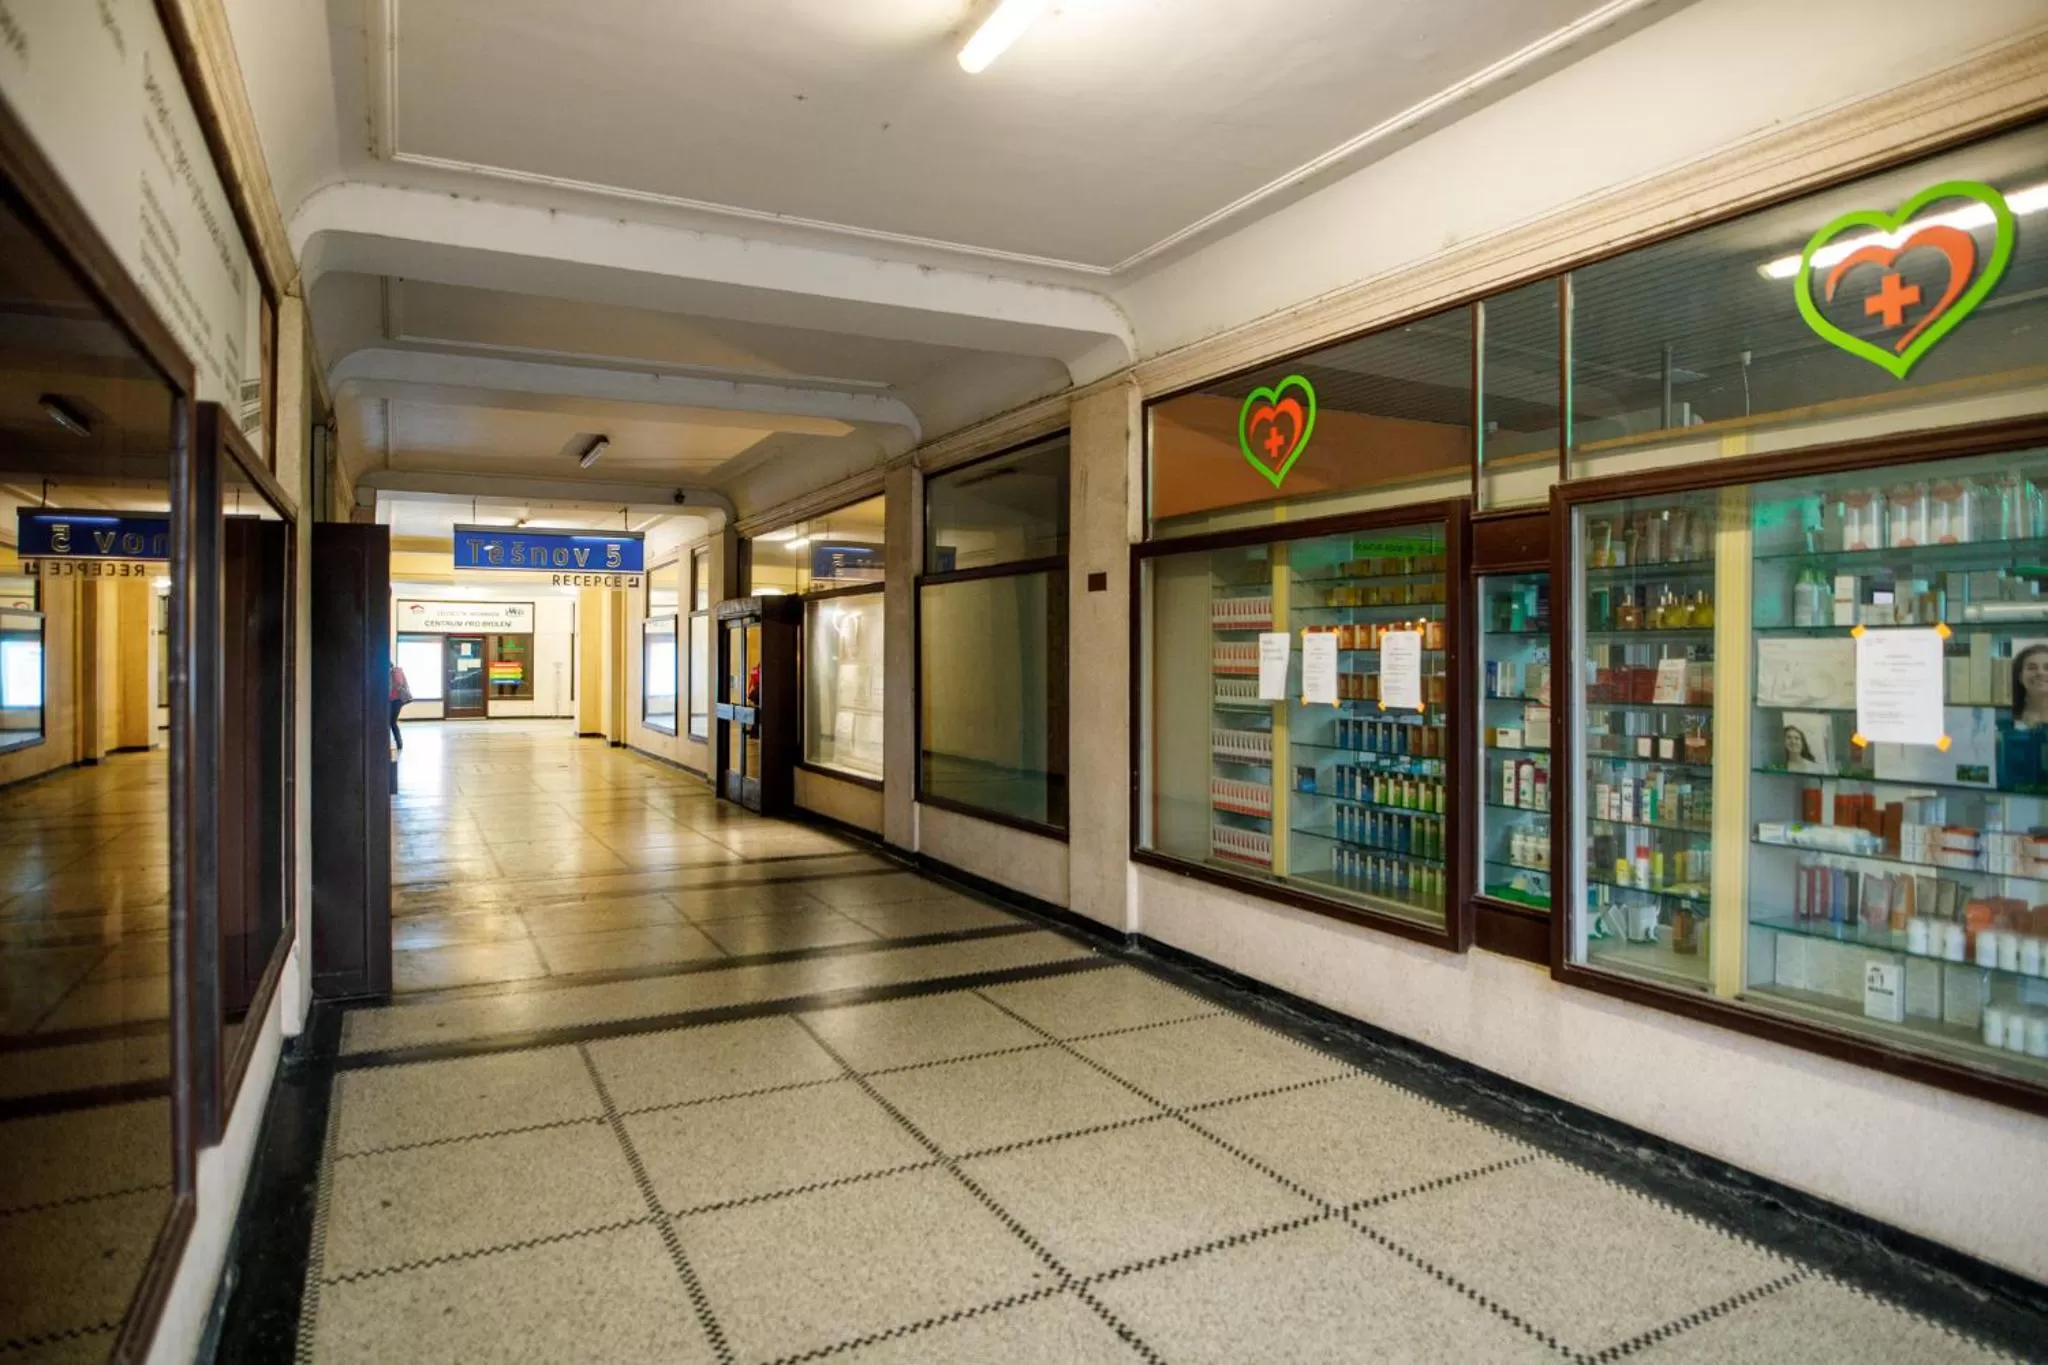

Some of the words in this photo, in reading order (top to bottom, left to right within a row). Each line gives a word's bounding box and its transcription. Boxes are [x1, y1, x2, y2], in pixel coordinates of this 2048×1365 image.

[467, 538, 590, 567] Těšnov
[606, 544, 622, 568] 5
[552, 574, 622, 588] RECEPCE
[424, 619, 463, 627] CENTRUM
